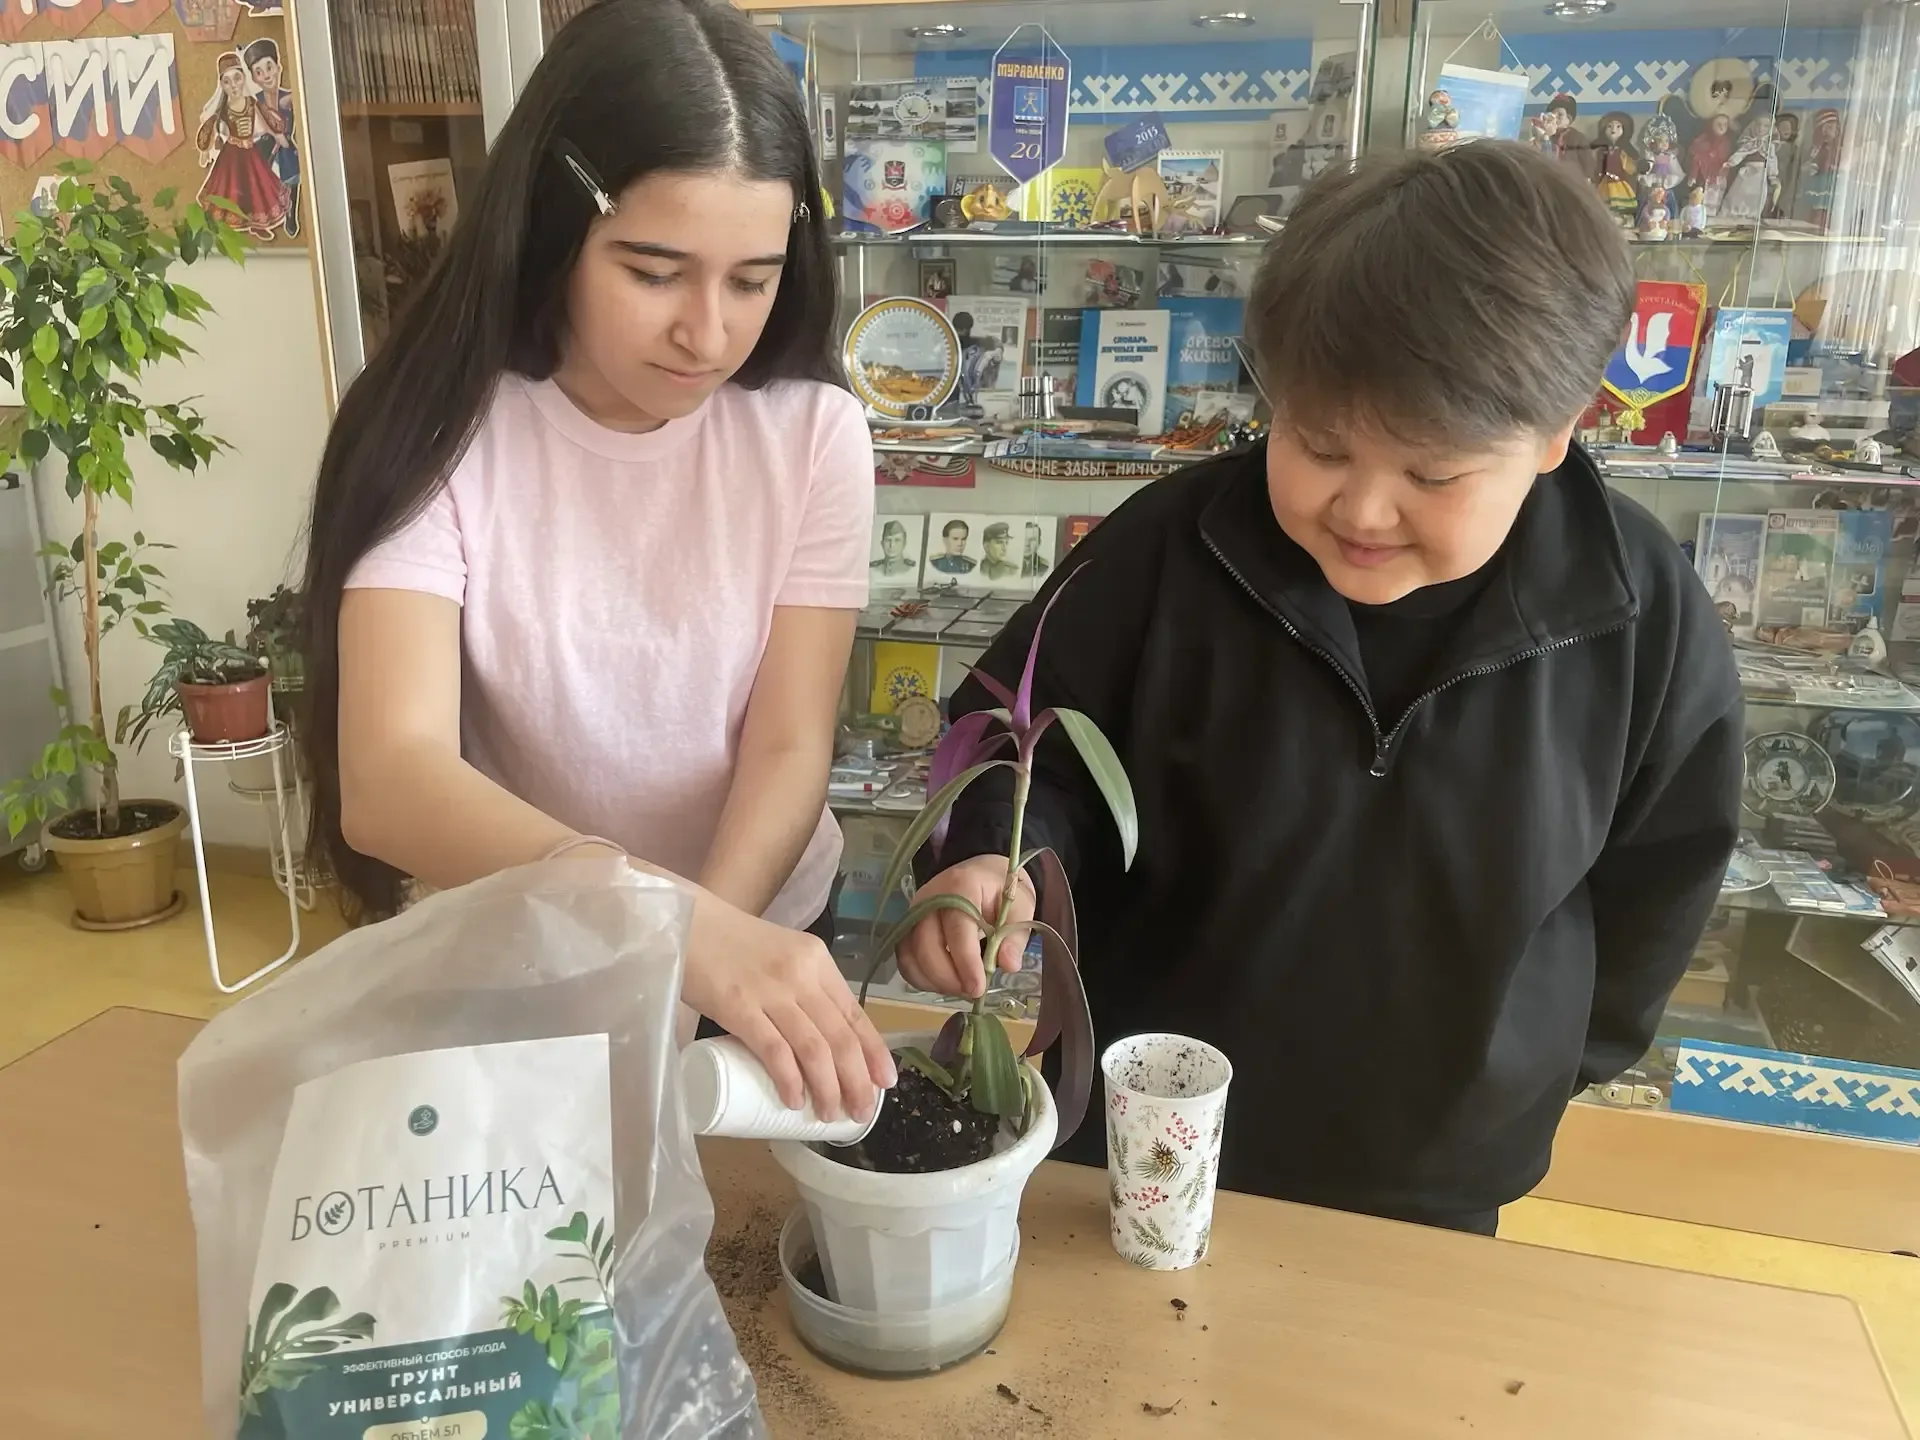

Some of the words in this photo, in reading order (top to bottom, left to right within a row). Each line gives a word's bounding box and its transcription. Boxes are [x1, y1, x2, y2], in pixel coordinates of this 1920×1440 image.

[997, 63, 1065, 80] МУРАВЛЕНКО
[1135, 126, 1159, 145] 2015
[1010, 142, 1041, 160] 20
[1041, 461, 1058, 476] НЕ
[1063, 460, 1109, 477] ЗАБЫТ,
[1116, 462, 1162, 475] НИЧТО
[290, 1165, 566, 1241] БОТАНИКА
[379, 1231, 471, 1250] PREMIUM
[342, 1354, 423, 1374] ЭФФЕКТИВНЫЙ
[425, 1348, 470, 1363] СПОСОБ
[471, 1341, 507, 1356] УХОДА
[390, 1365, 459, 1387] ГРУНТ
[328, 1371, 522, 1416] УНИВЕРСАЛЬНЫЙ
[443, 1423, 462, 1437] 5Л
